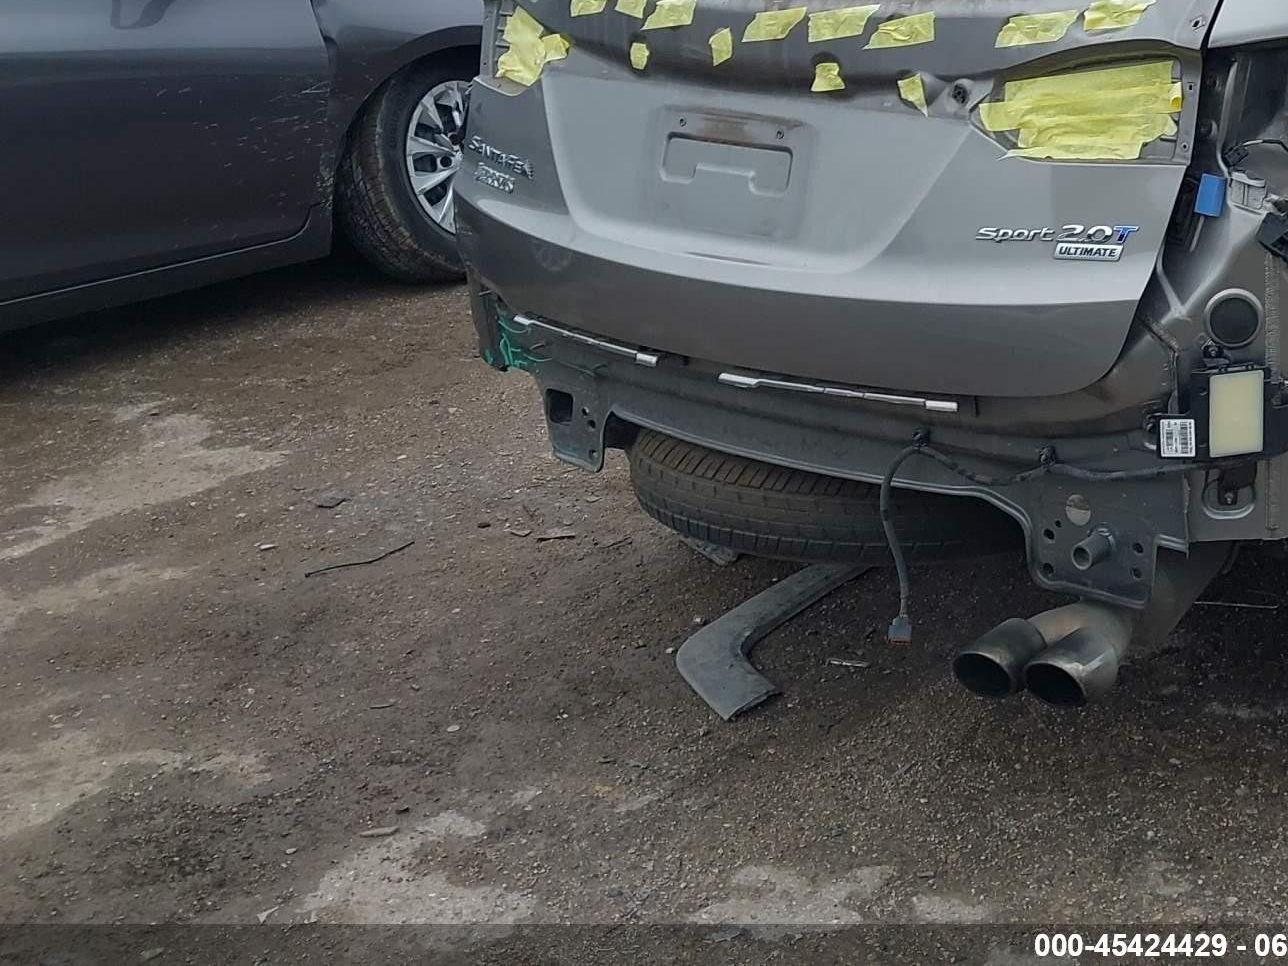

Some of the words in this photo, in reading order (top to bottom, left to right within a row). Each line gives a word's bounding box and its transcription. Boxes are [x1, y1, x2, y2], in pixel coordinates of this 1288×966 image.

[975, 226, 1055, 243] Sport
[1056, 224, 1139, 244] 2.0T
[1058, 246, 1118, 258] ULTIMATE
